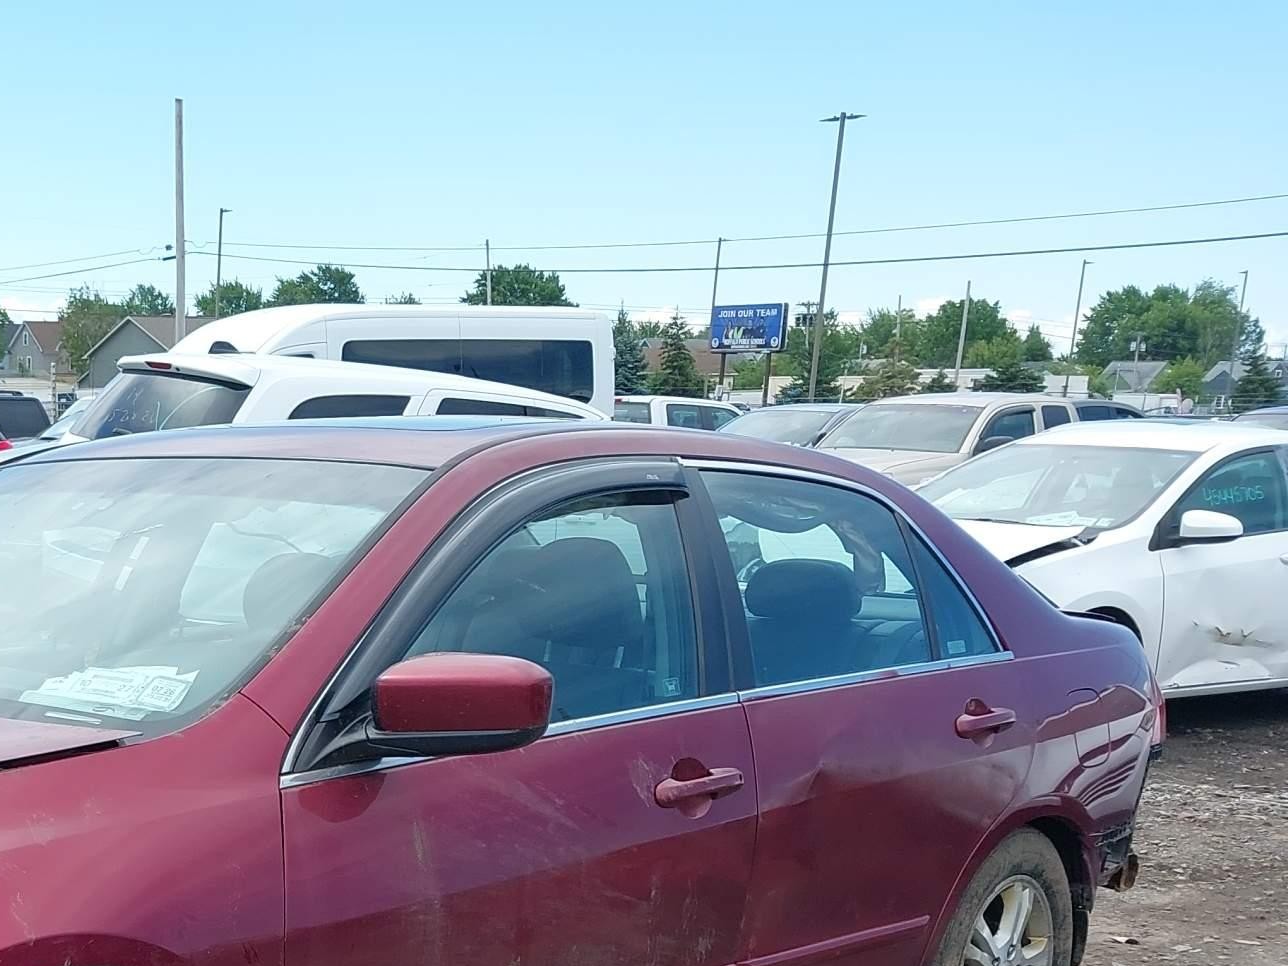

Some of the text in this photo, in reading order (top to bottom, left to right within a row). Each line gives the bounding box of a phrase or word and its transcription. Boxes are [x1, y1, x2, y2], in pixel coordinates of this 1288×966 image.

[718, 308, 778, 318] JOIN OUR TEAM
